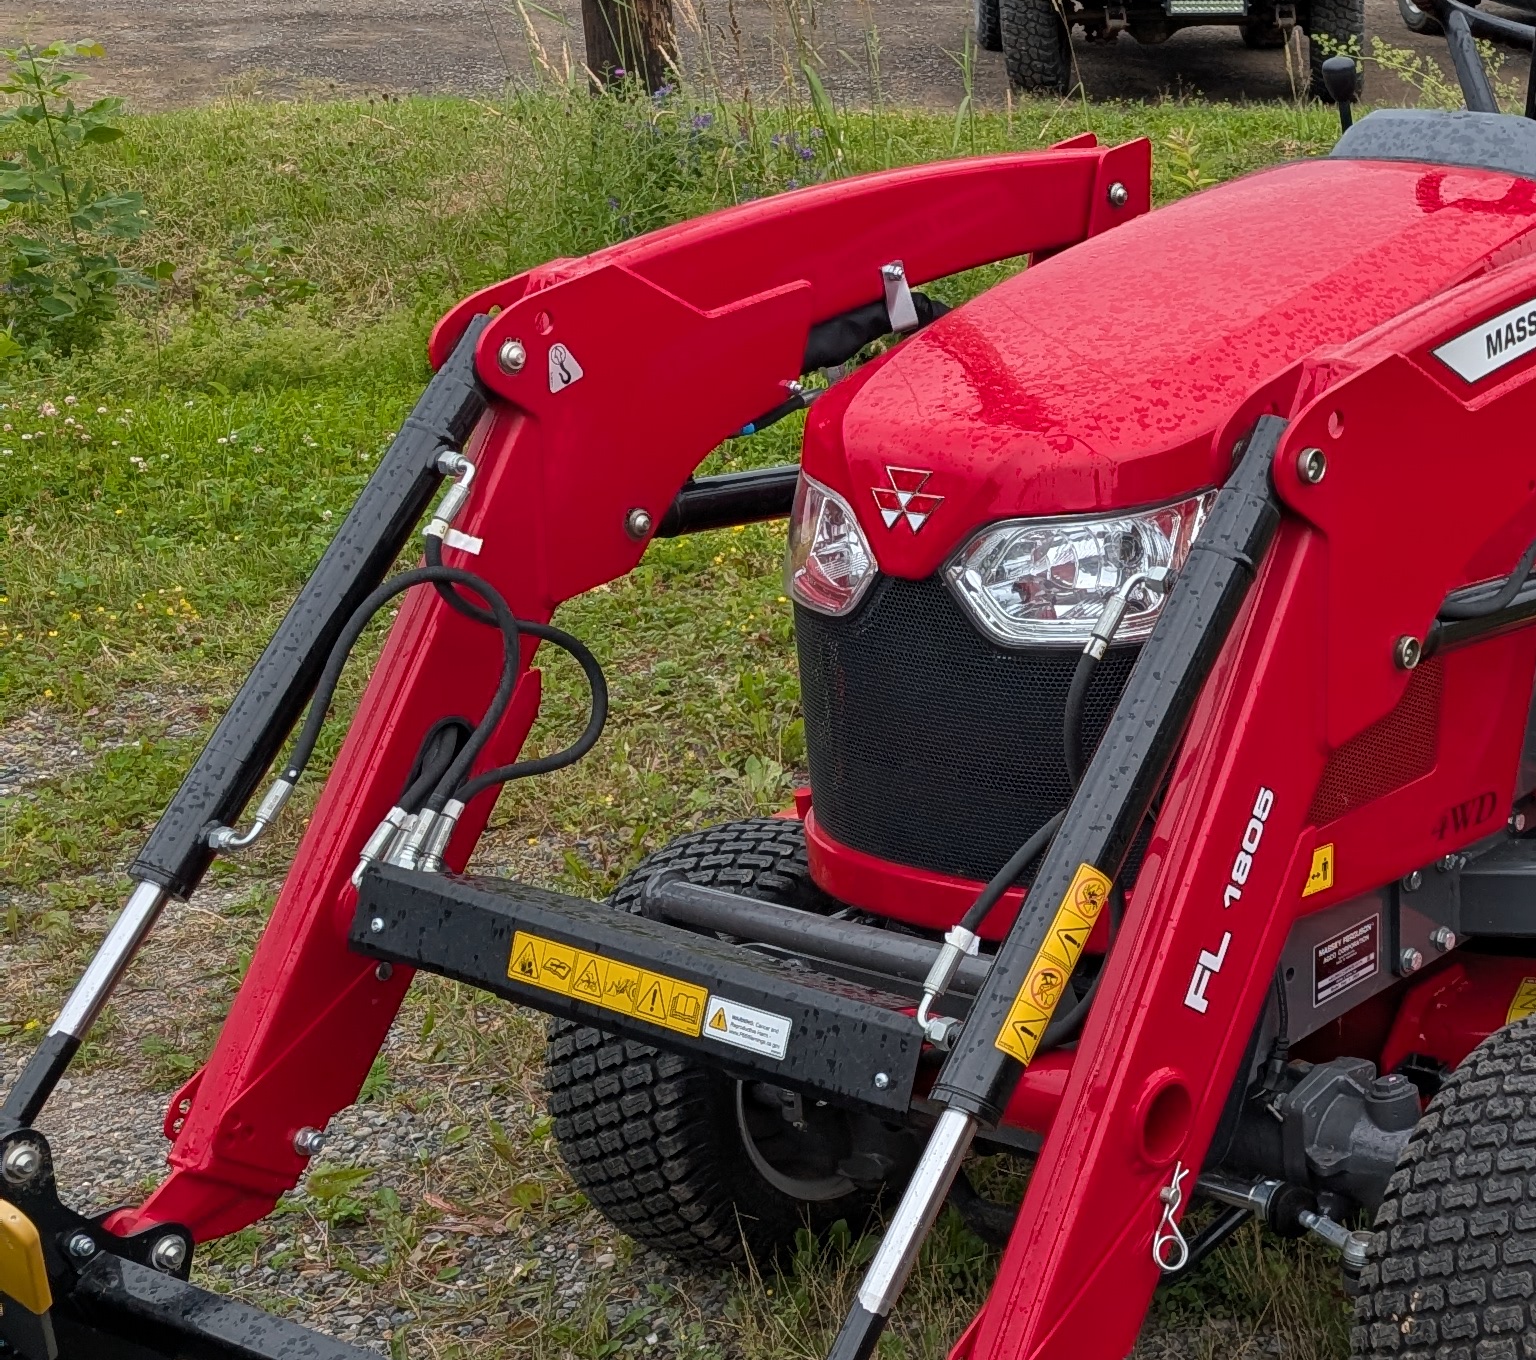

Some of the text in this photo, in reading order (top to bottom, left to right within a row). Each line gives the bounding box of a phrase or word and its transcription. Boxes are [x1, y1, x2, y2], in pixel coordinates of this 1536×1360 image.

[439, 525, 446, 534] 3
[1430, 791, 1497, 840] 4WD
[1184, 786, 1275, 1014] FL 1805
